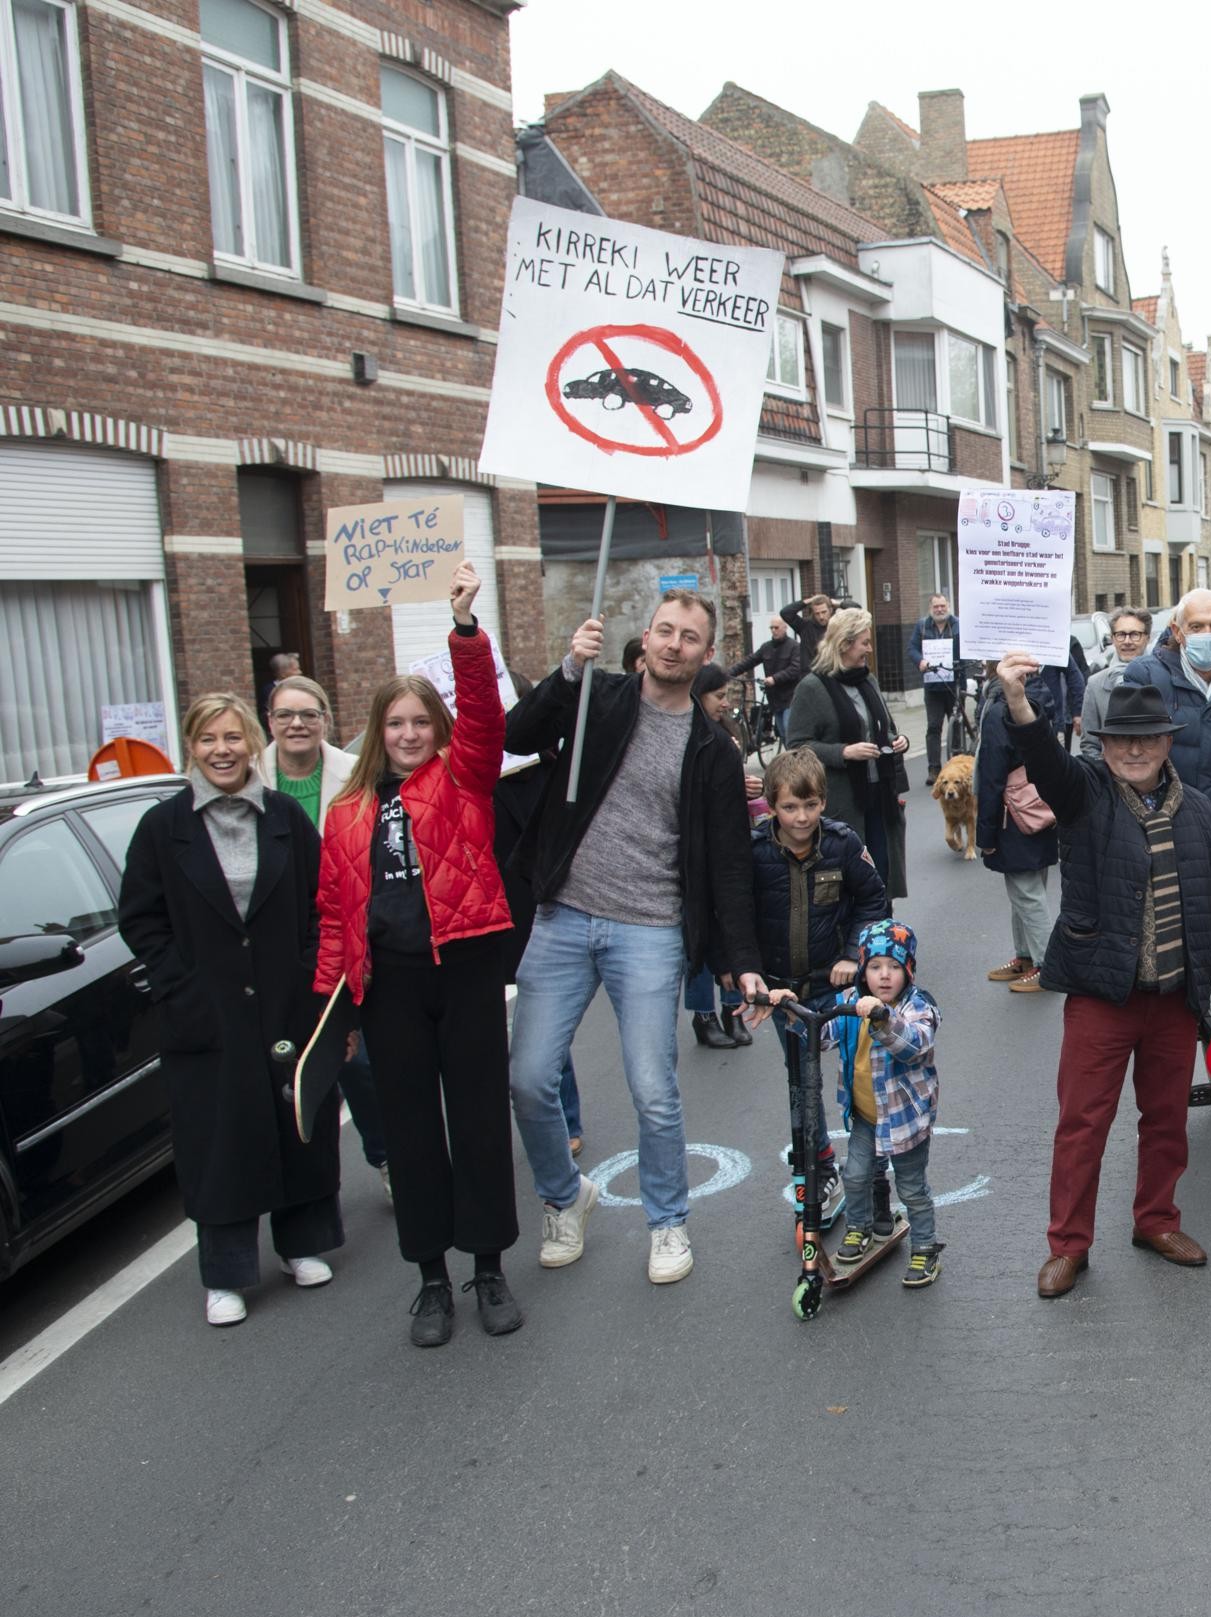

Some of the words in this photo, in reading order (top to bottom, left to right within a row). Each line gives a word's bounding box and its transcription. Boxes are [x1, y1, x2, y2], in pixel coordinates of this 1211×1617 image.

[536, 221, 638, 269] KIRREKI
[665, 251, 741, 286] WEER
[515, 258, 576, 290] MET
[584, 269, 617, 296] AL
[626, 275, 674, 303] DAT
[680, 285, 770, 328] VERKEER
